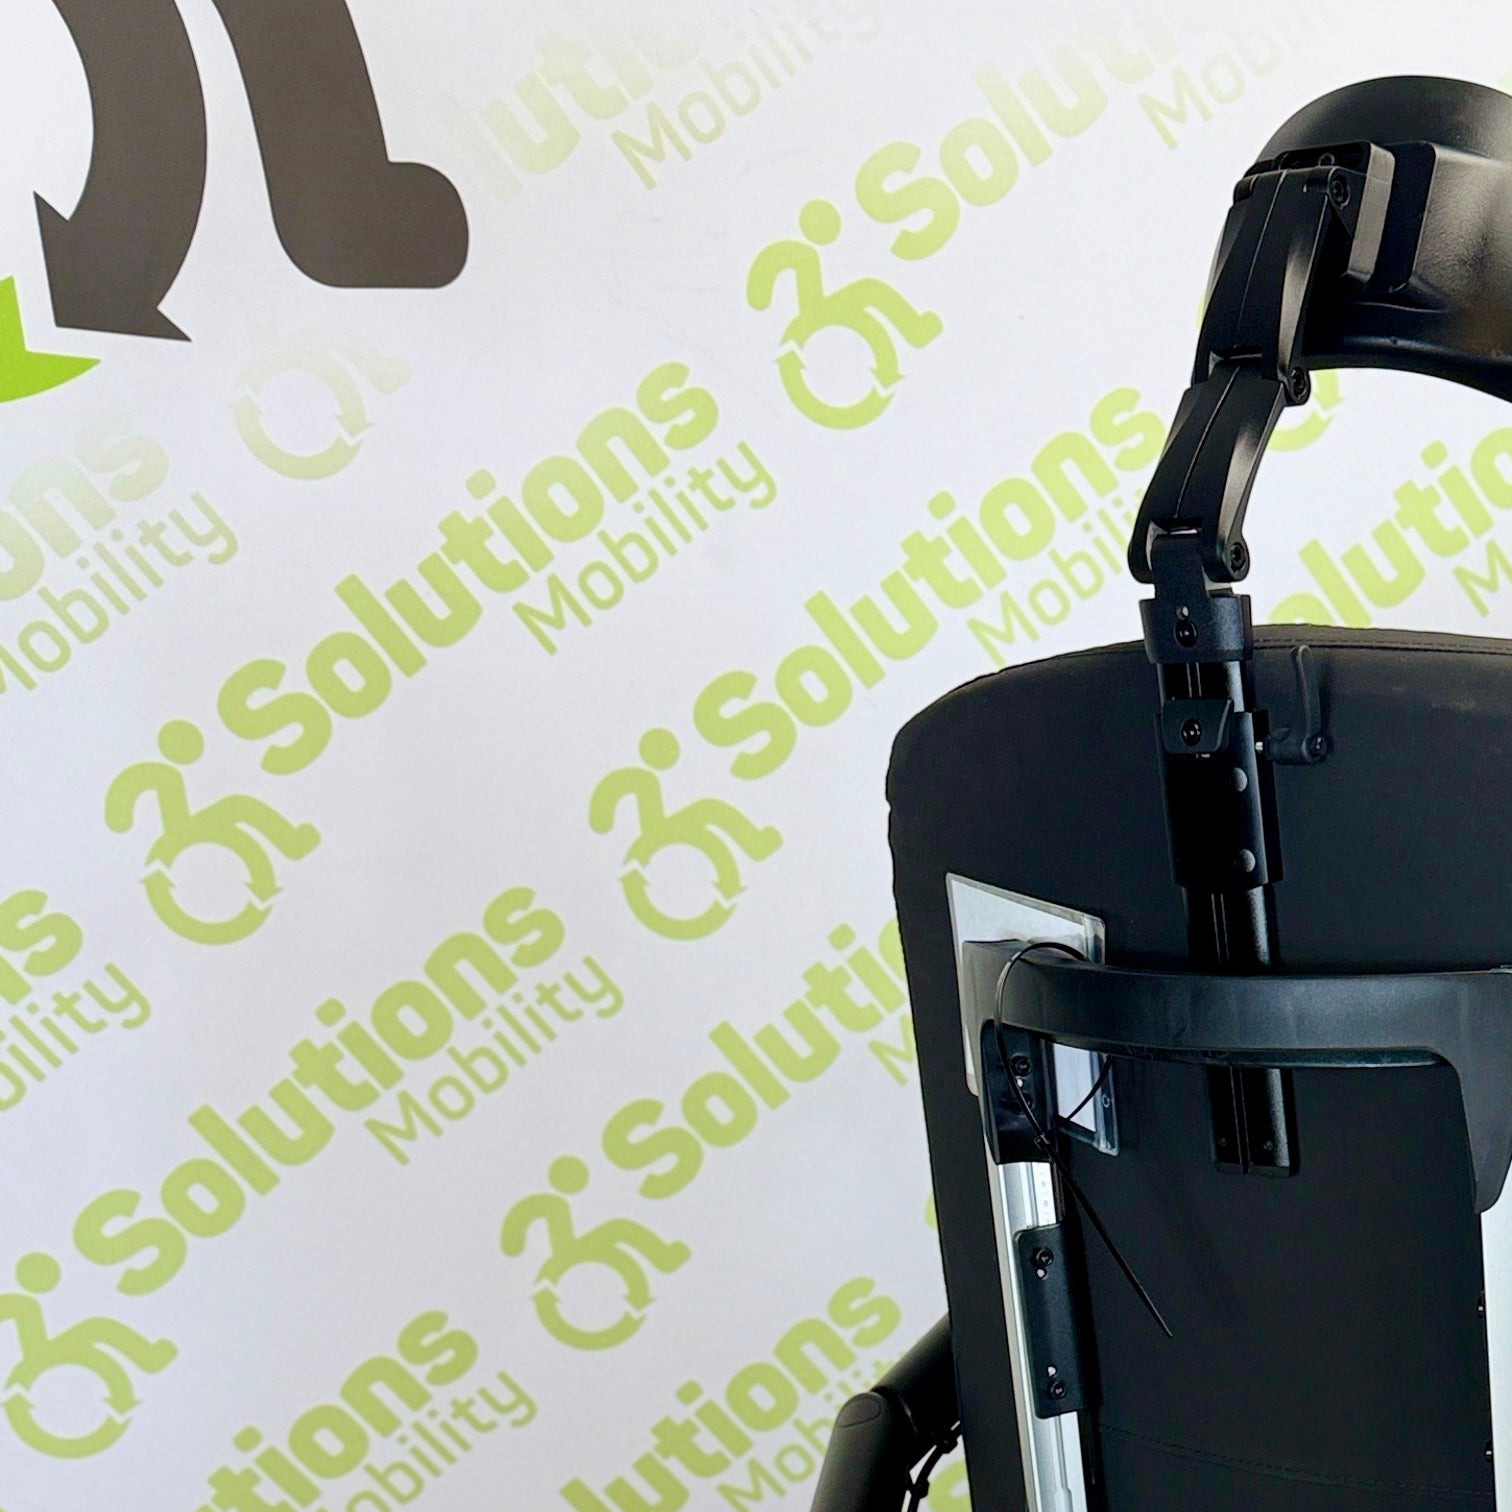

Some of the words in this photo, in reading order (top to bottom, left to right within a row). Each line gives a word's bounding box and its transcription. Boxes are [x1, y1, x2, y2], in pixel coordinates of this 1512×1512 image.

[217, 362, 719, 776] Solutions
[513, 441, 777, 656] Mobility
[693, 387, 1167, 781] Solutions
[72, 886, 565, 1297] Solutions
[365, 954, 624, 1166] Mobility
